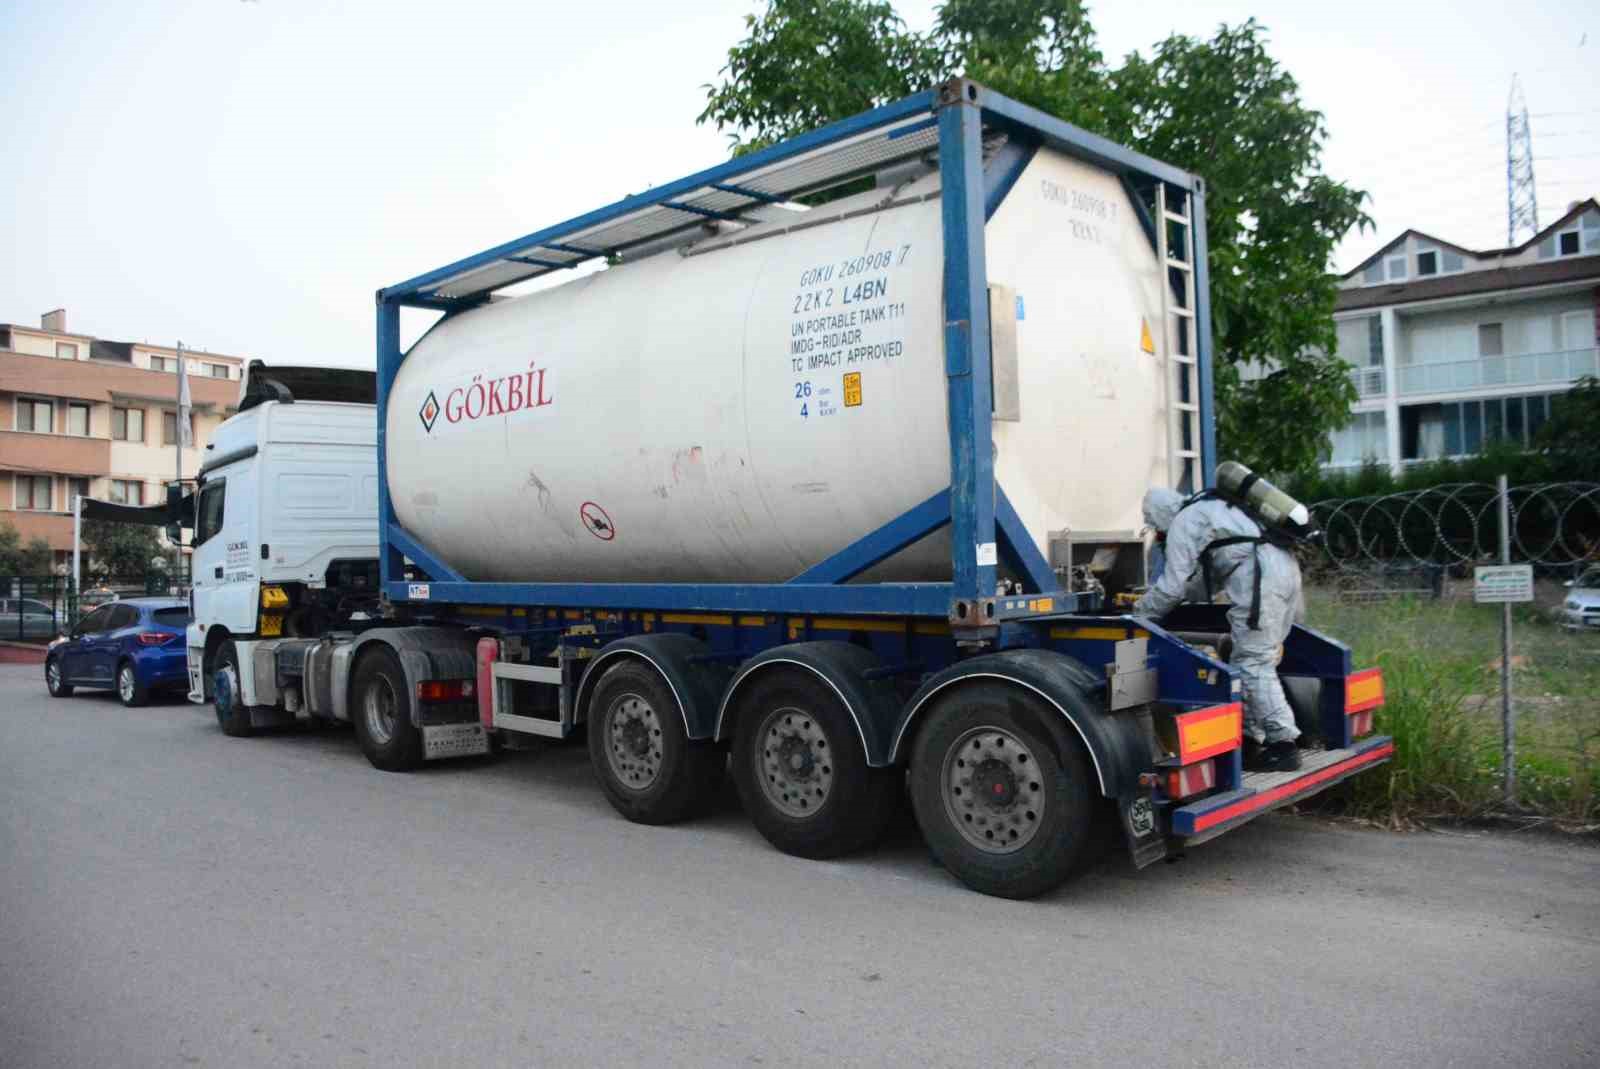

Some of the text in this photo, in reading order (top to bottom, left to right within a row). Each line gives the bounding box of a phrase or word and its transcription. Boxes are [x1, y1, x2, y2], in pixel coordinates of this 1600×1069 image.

[800, 244, 912, 288] GOKU 260908 7
[792, 277, 888, 314] 22K2 L4BN
[791, 303, 905, 337] UN PORTABLE TANK T11
[791, 340, 903, 373] TC IMPACT APPROVED
[794, 380, 813, 399] 26
[799, 402, 809, 419] 4
